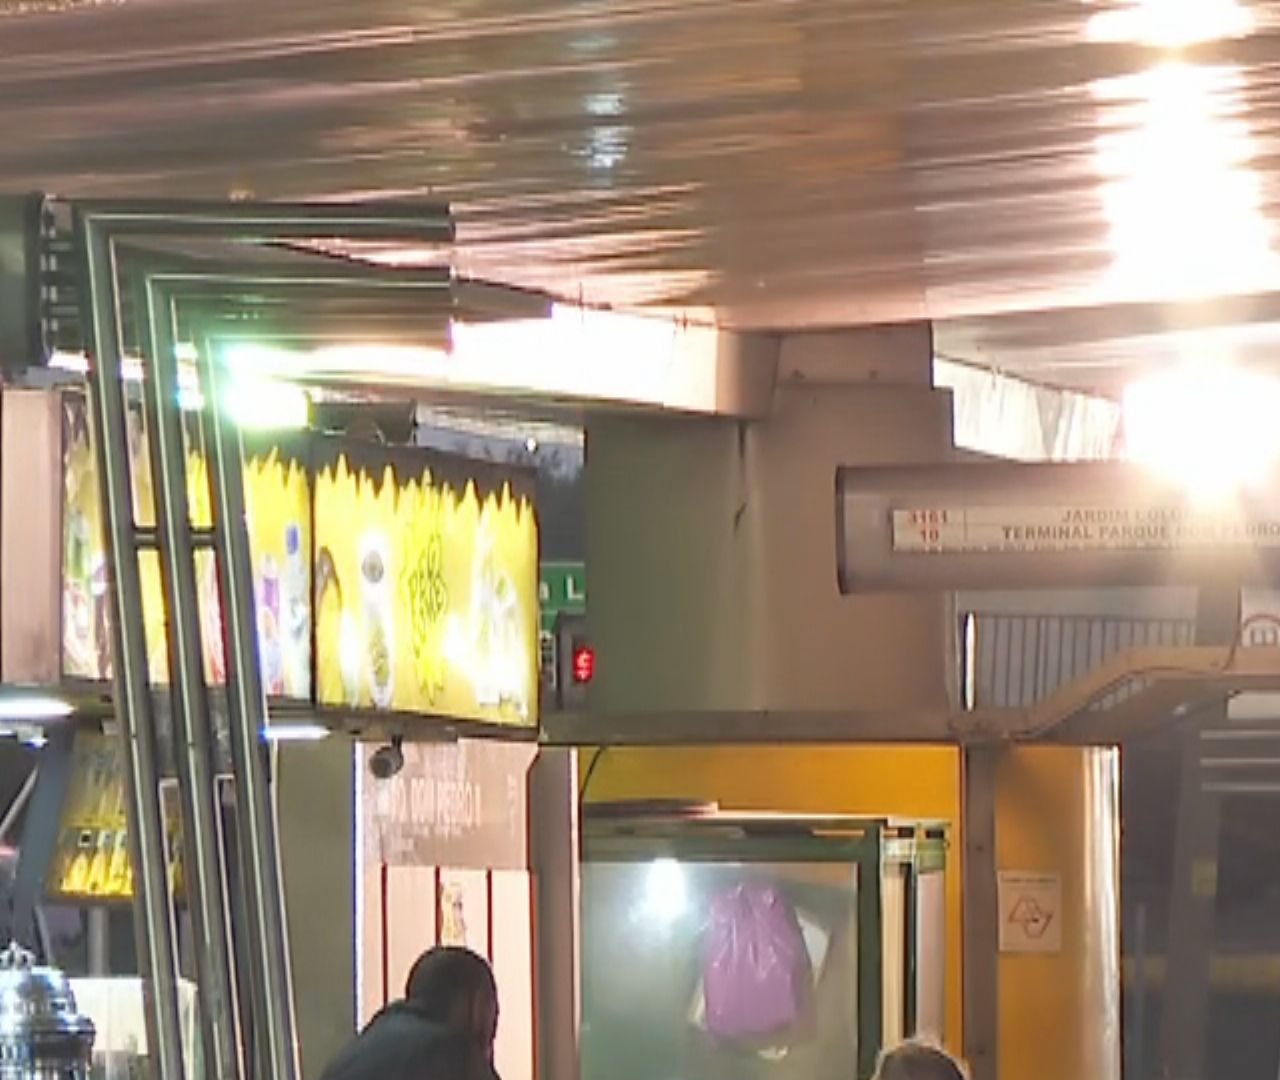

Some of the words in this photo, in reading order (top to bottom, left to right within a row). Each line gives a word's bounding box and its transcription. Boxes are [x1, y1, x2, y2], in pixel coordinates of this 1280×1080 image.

[1061, 508, 1129, 524] JARDIM
[919, 527, 941, 543] 10
[1002, 525, 1093, 541] TERMINAL
[1098, 524, 1169, 540] PARQUE
